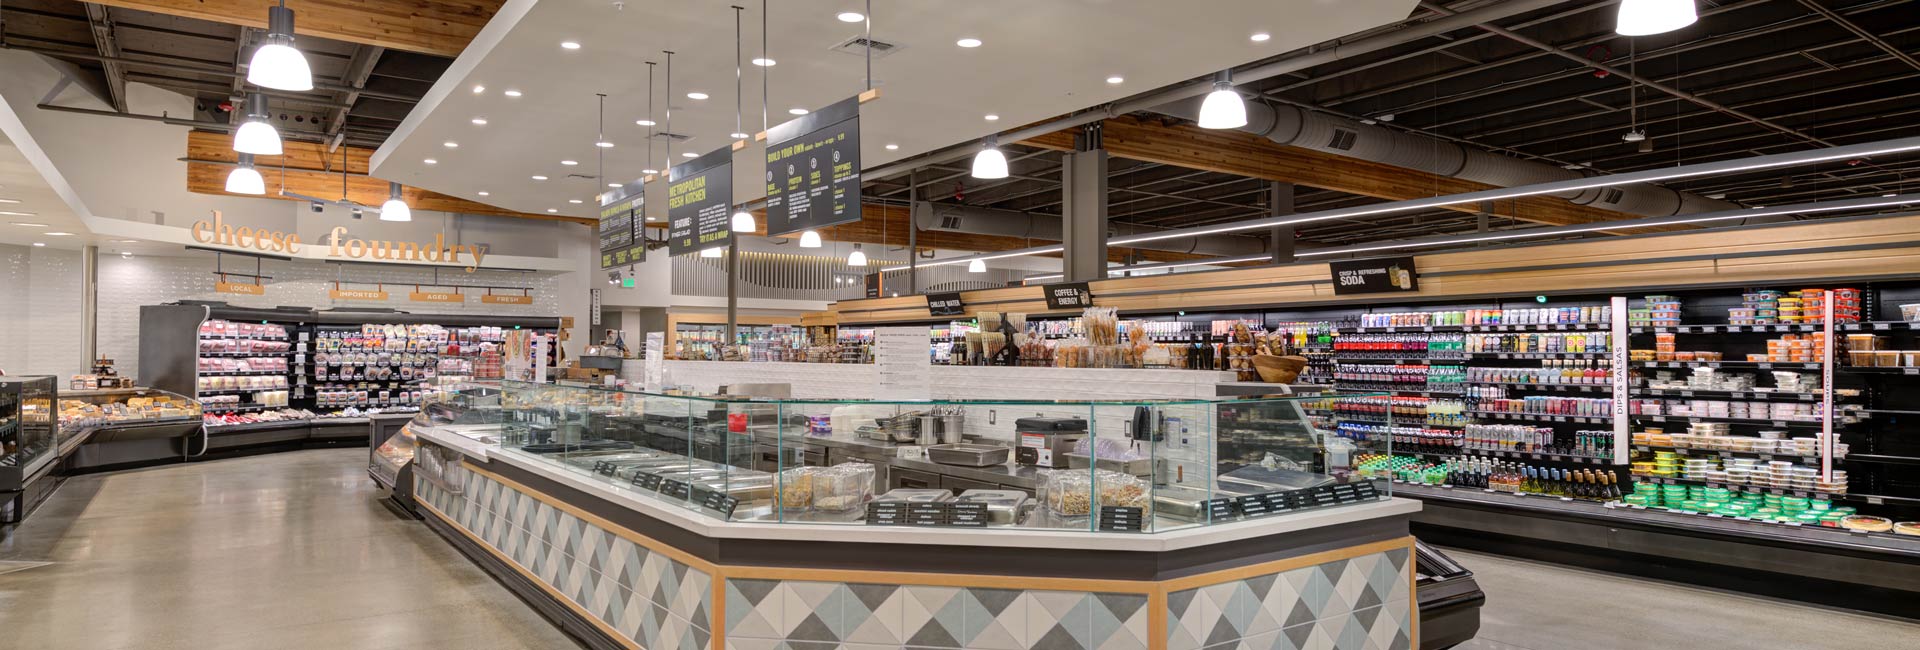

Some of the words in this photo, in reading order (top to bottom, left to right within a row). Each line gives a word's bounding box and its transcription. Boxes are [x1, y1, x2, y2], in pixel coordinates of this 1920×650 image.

[768, 152, 780, 163] BUILD
[781, 146, 793, 159] YOUR
[794, 144, 804, 155] OWN
[669, 176, 706, 197] METROPOLITAN
[669, 194, 684, 209] FRESH
[685, 188, 706, 205] KITCHEN
[192, 210, 302, 254] cheese
[328, 226, 488, 273] foundry
[1340, 276, 1365, 285] SODA
[1058, 297, 1078, 305] ENERGY
